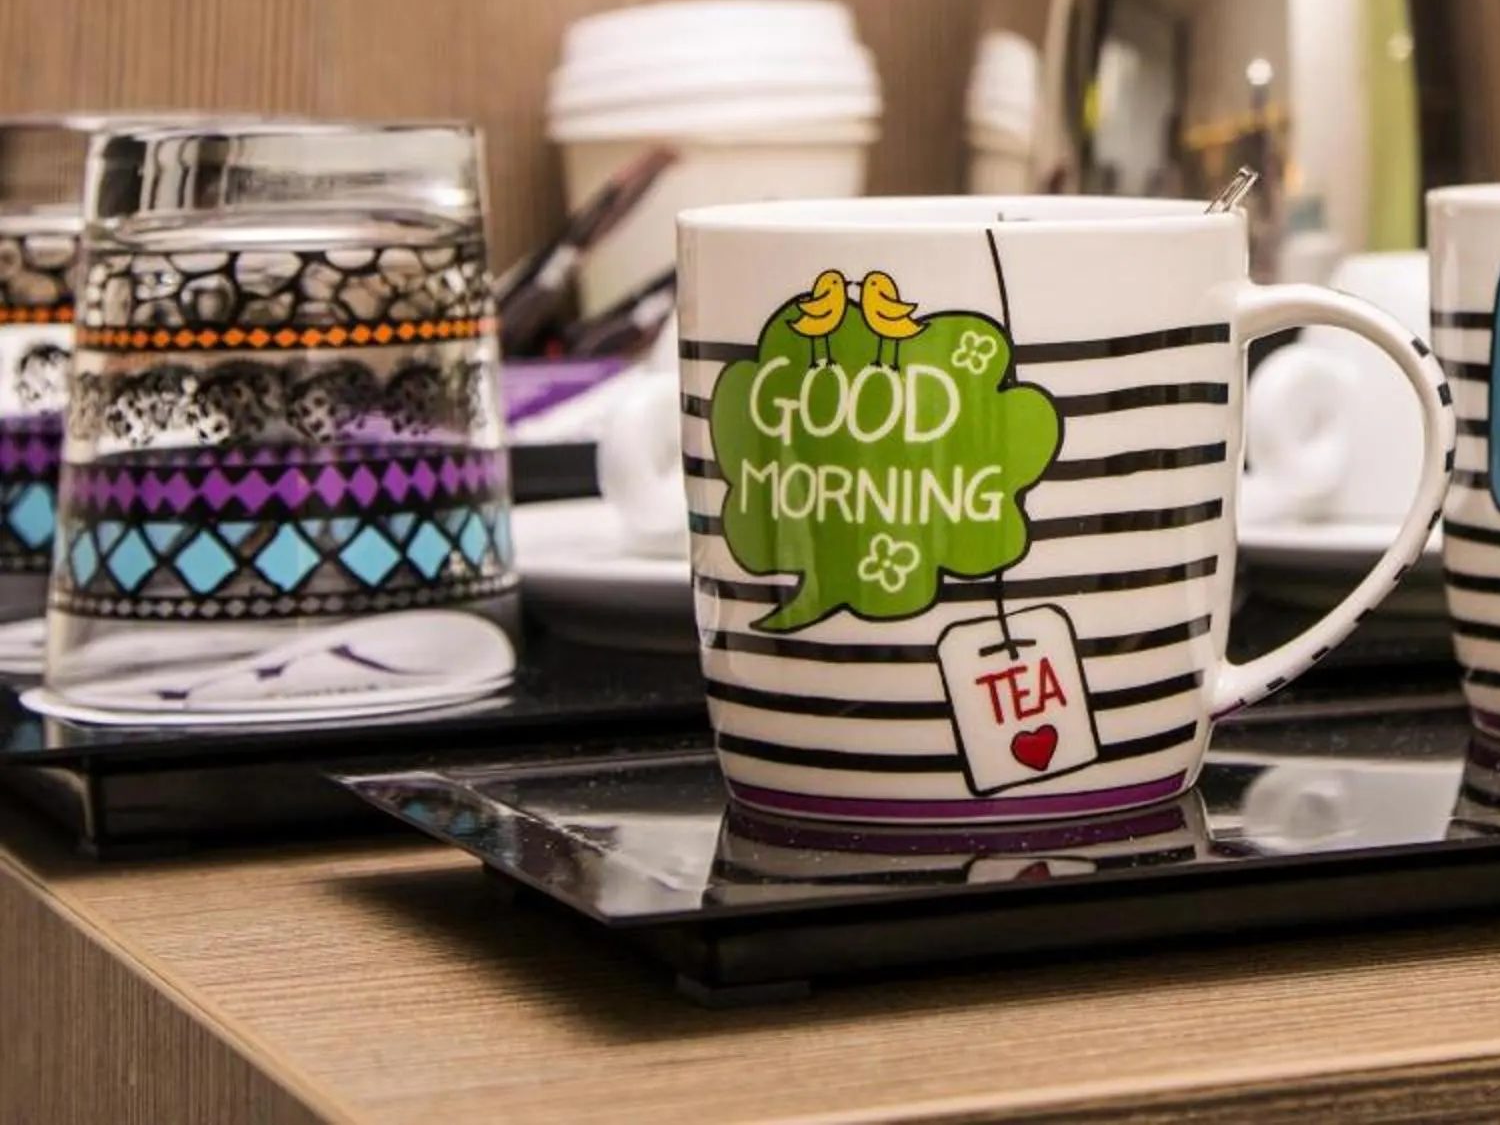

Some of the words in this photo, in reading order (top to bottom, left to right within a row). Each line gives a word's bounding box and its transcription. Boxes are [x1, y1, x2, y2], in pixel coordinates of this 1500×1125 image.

[749, 356, 961, 446] GOOD
[739, 458, 1004, 524] MORNING
[975, 657, 1067, 725] TEA
